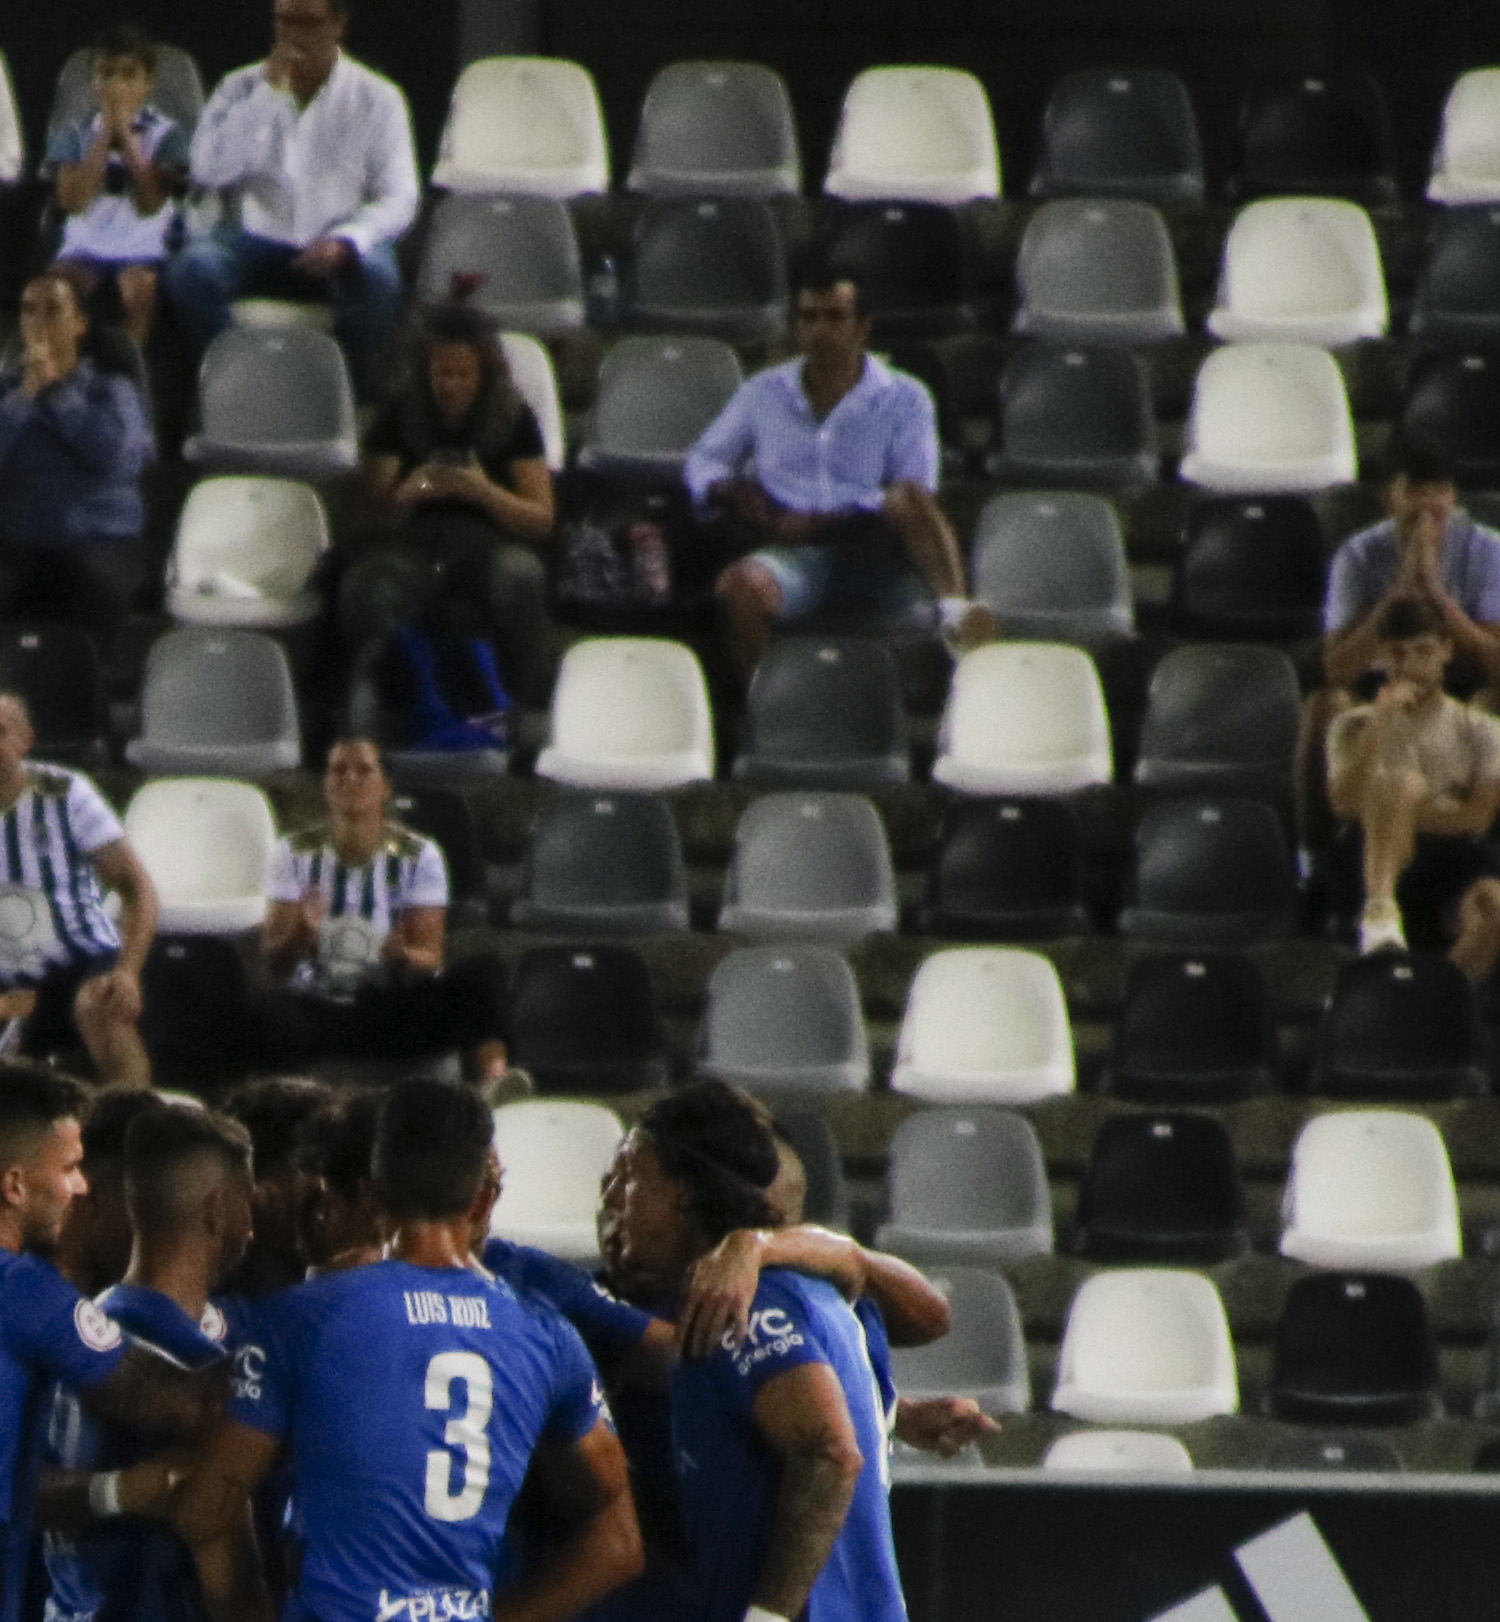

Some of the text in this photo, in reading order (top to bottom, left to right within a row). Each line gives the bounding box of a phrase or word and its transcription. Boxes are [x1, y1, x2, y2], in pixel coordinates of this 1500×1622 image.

[404, 1291, 493, 1329] LUIS RUIZ
[424, 1351, 493, 1522] 3
